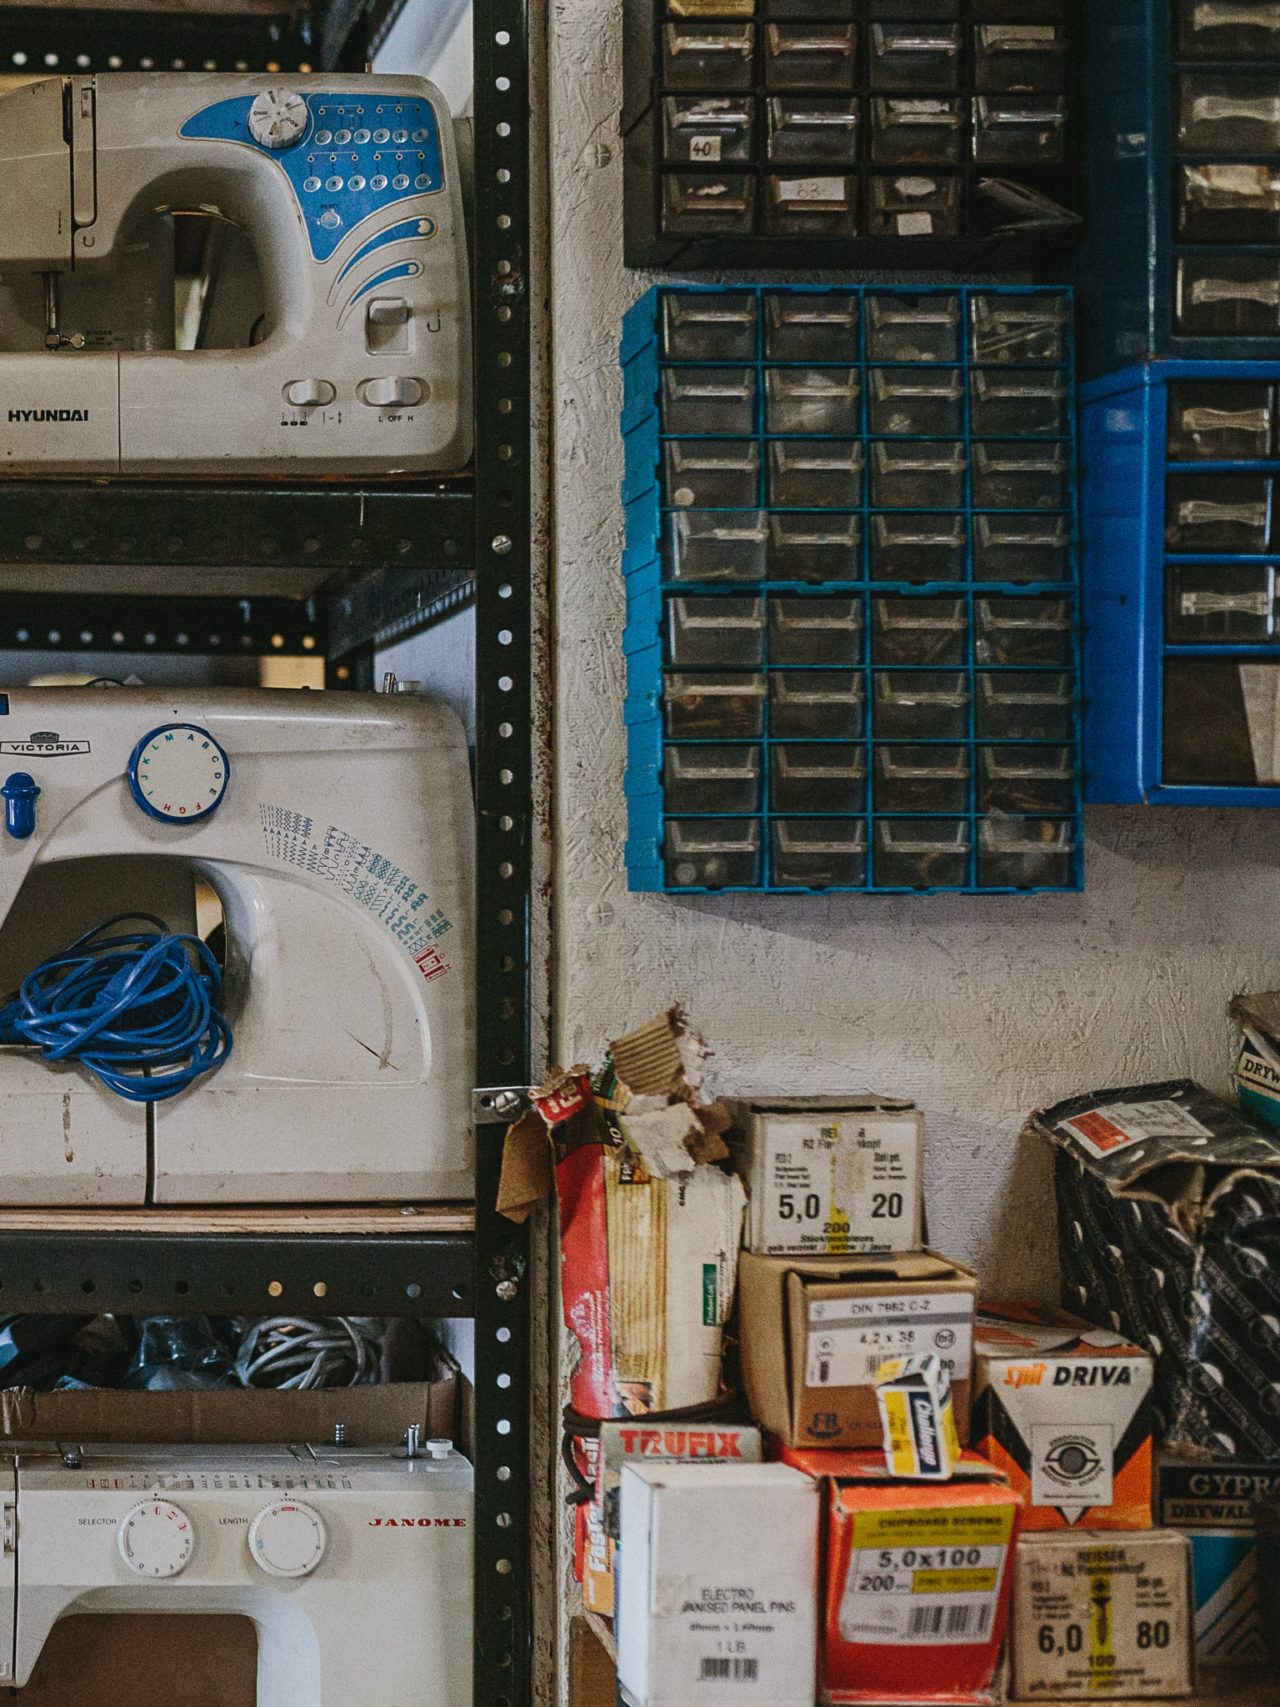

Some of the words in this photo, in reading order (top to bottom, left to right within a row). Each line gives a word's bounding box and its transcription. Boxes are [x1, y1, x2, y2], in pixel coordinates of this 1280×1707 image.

[692, 142, 712, 156] 40
[8, 410, 88, 422] HYUNDAI
[165, 734, 173, 742] M
[10, 743, 81, 752] VICTORIA
[152, 743, 159, 751] L
[202, 741, 210, 750] B
[142, 757, 150, 765] K
[211, 755, 219, 763] C
[214, 771, 221, 779] D
[209, 787, 218, 796] E
[163, 803, 171, 812] H
[179, 806, 186, 814] G
[194, 803, 203, 811] F
[779, 1194, 820, 1223] 5,0
[871, 1193, 903, 1219] 20
[823, 1222, 850, 1234] 200
[852, 1303, 873, 1314] DIN
[899, 1331, 915, 1343] 38
[1053, 1366, 1131, 1386] DRIVA
[915, 1400, 937, 1467] Challenge
[619, 1430, 742, 1458] TRUFIX
[78, 1518, 117, 1526] SELECTOR
[219, 1518, 248, 1526] LENGTH
[878, 1549, 981, 1573] 5,0x100
[859, 1575, 895, 1592] 200
[701, 1587, 755, 1602] ELECTRO
[732, 1602, 767, 1614] PANEL
[770, 1602, 796, 1614] PINS
[1039, 1624, 1083, 1657] 6,0
[1137, 1621, 1170, 1649] 80
[728, 1641, 746, 1653] LB
